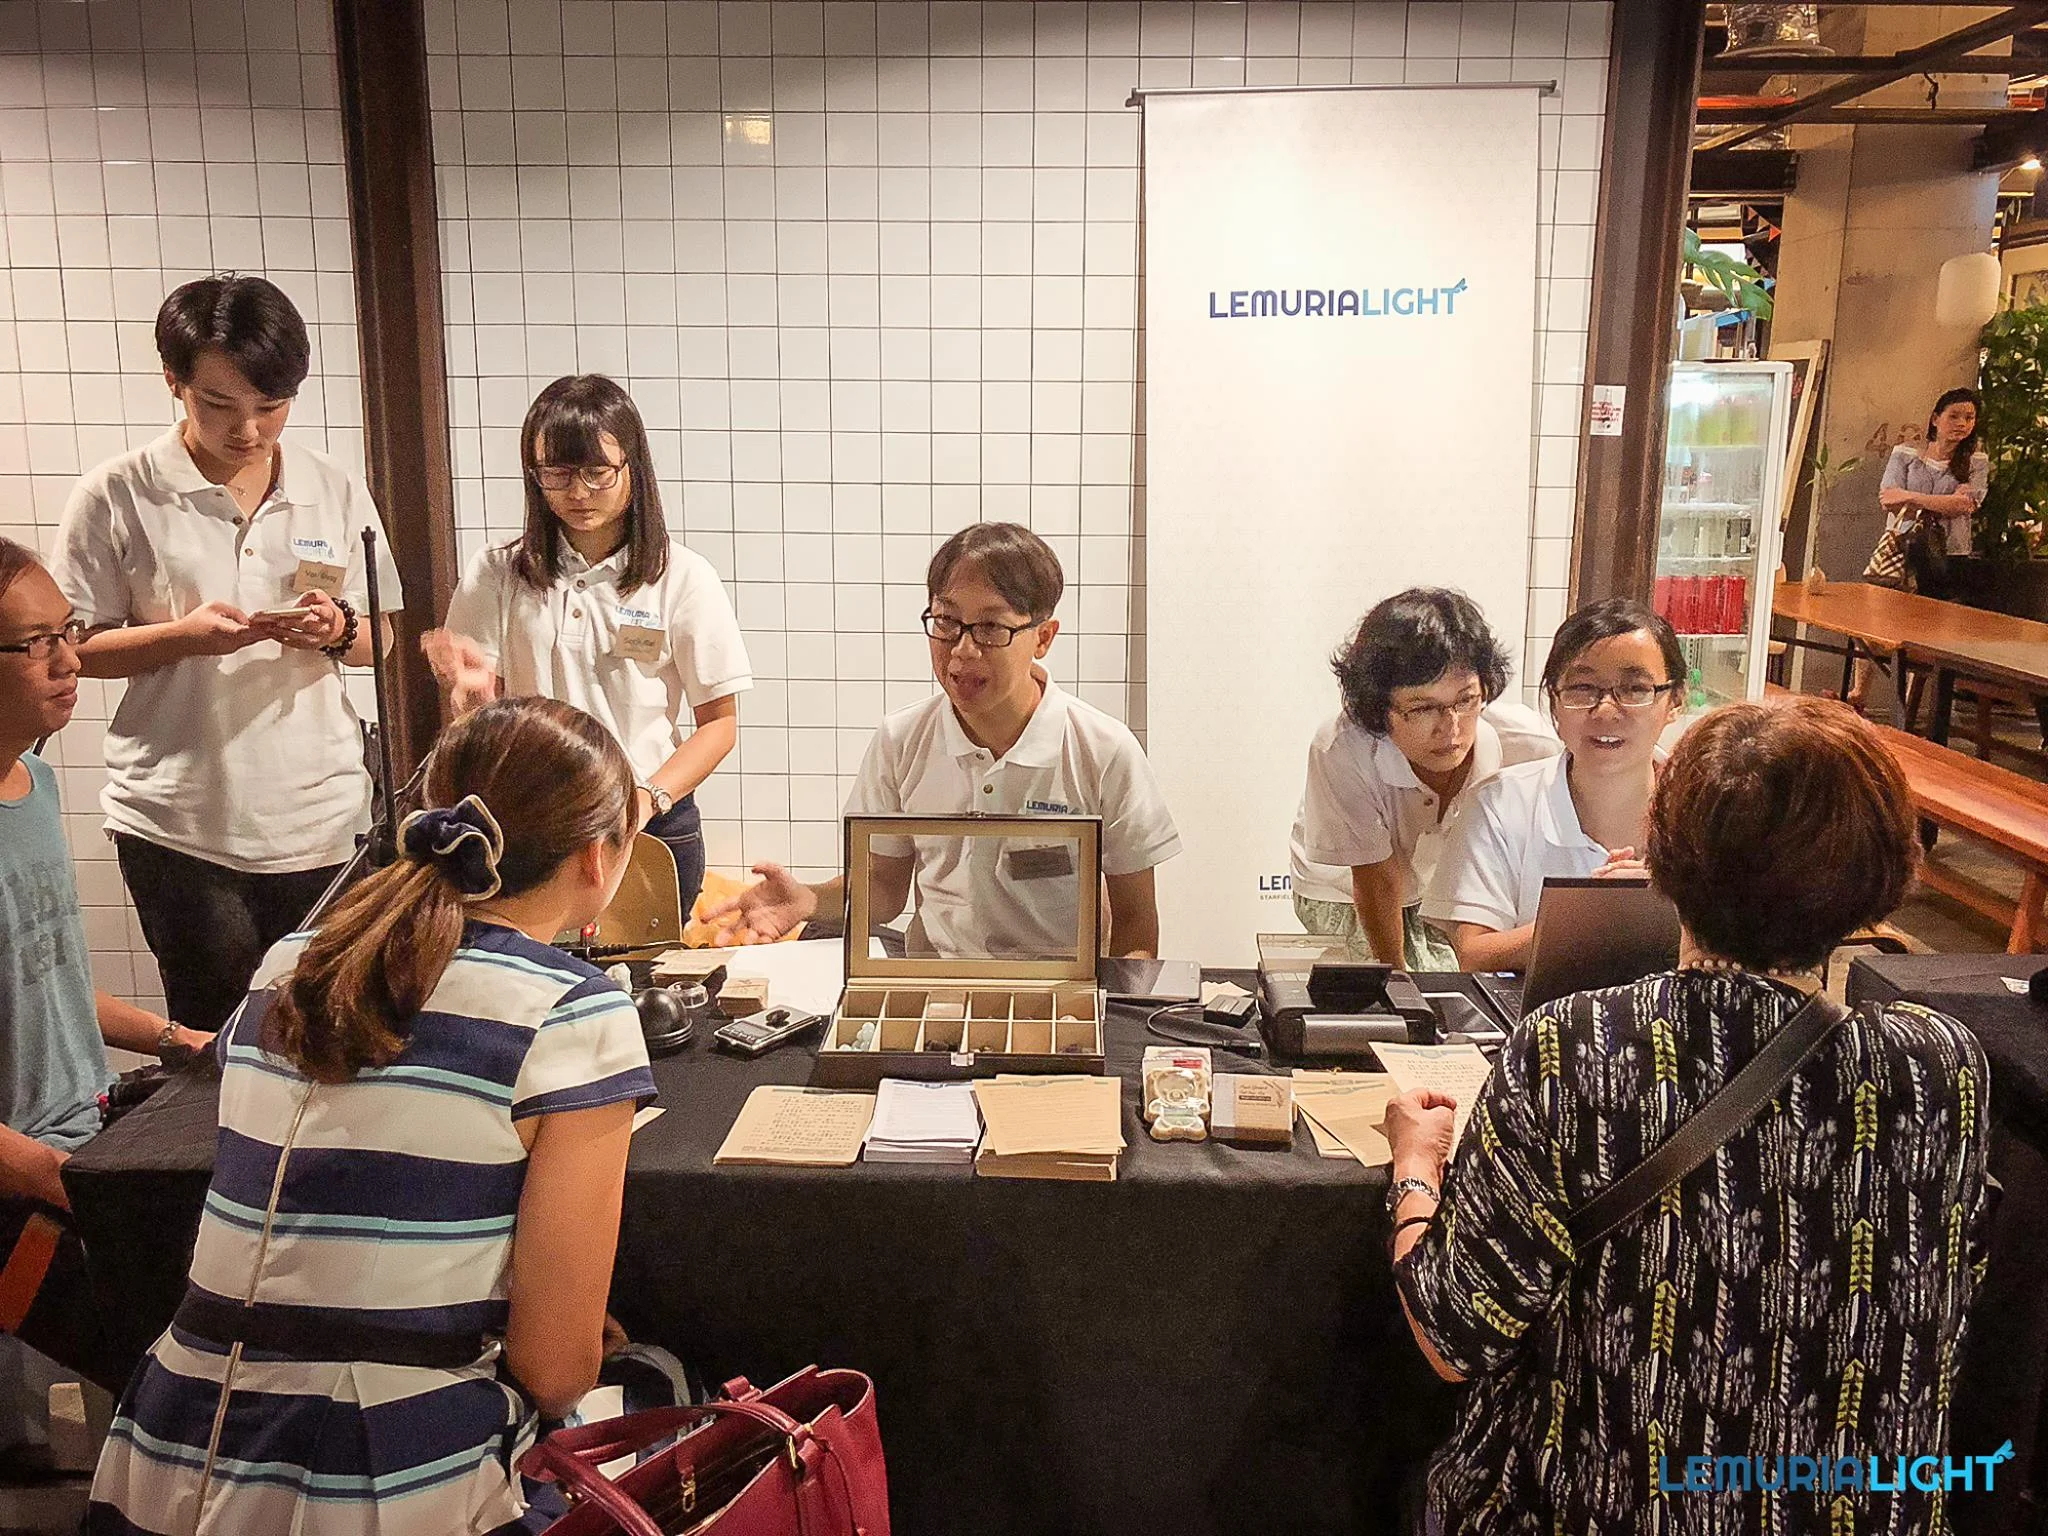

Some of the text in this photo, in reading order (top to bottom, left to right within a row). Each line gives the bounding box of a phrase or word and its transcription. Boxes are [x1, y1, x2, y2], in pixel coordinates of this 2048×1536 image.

[1209, 287, 1462, 319] LEMURIALIGHT
[615, 605, 651, 619] LEMURIA
[1026, 800, 1068, 814] LEMURIA
